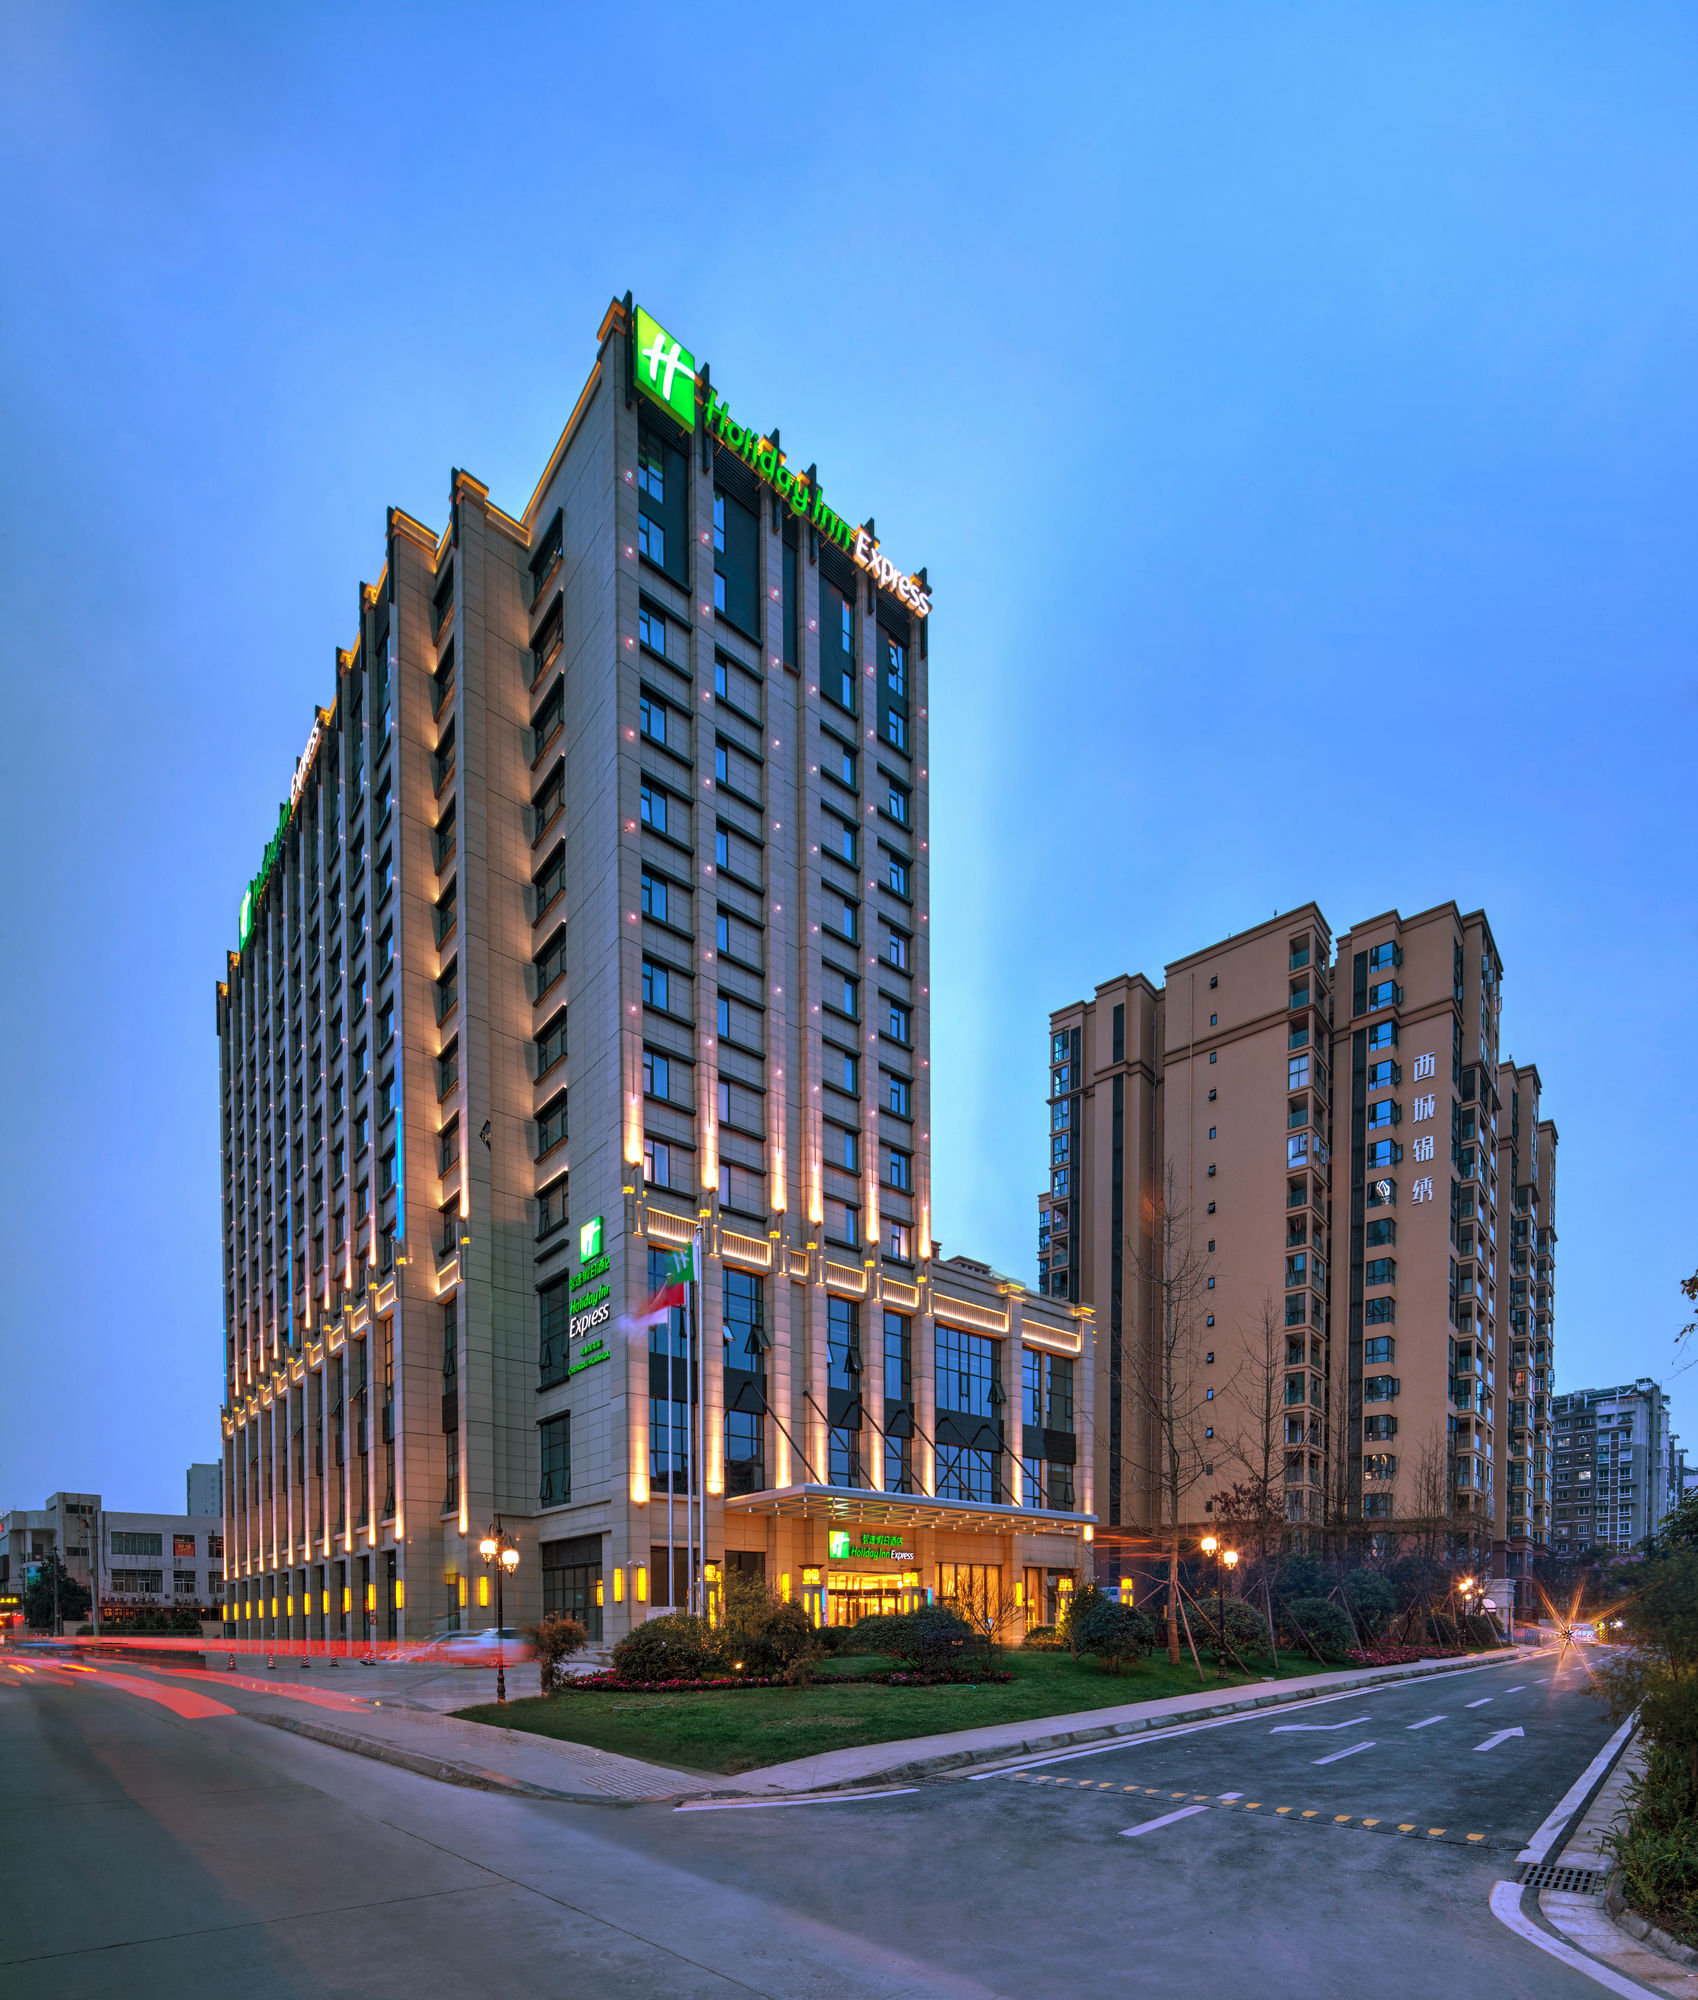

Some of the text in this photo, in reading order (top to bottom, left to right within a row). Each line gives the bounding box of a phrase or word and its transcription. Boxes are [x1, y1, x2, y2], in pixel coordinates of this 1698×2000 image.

[702, 388, 933, 618] Holiday Inn Express
[1412, 1051, 1436, 1206] 西城锦绣
[569, 1289, 600, 1316] Holiday
[569, 1303, 610, 1338] Express
[851, 1546, 914, 1561] Holiday Inn Express
